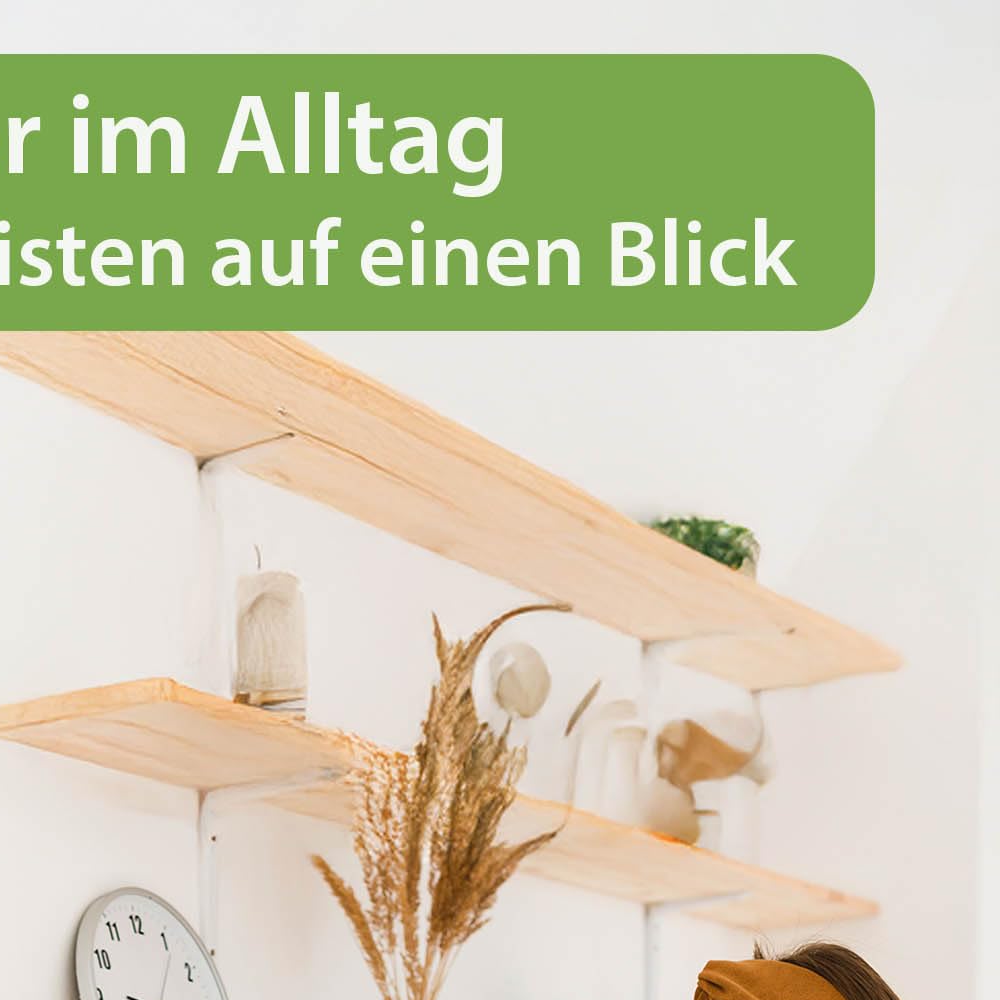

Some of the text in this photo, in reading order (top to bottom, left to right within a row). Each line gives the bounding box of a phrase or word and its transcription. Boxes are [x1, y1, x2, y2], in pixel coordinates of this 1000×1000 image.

[106, 921, 120, 942] 11
[128, 915, 144, 935] 12
[160, 932, 168, 950] 1
[94, 949, 111, 970] 10
[184, 962, 194, 982] 2
